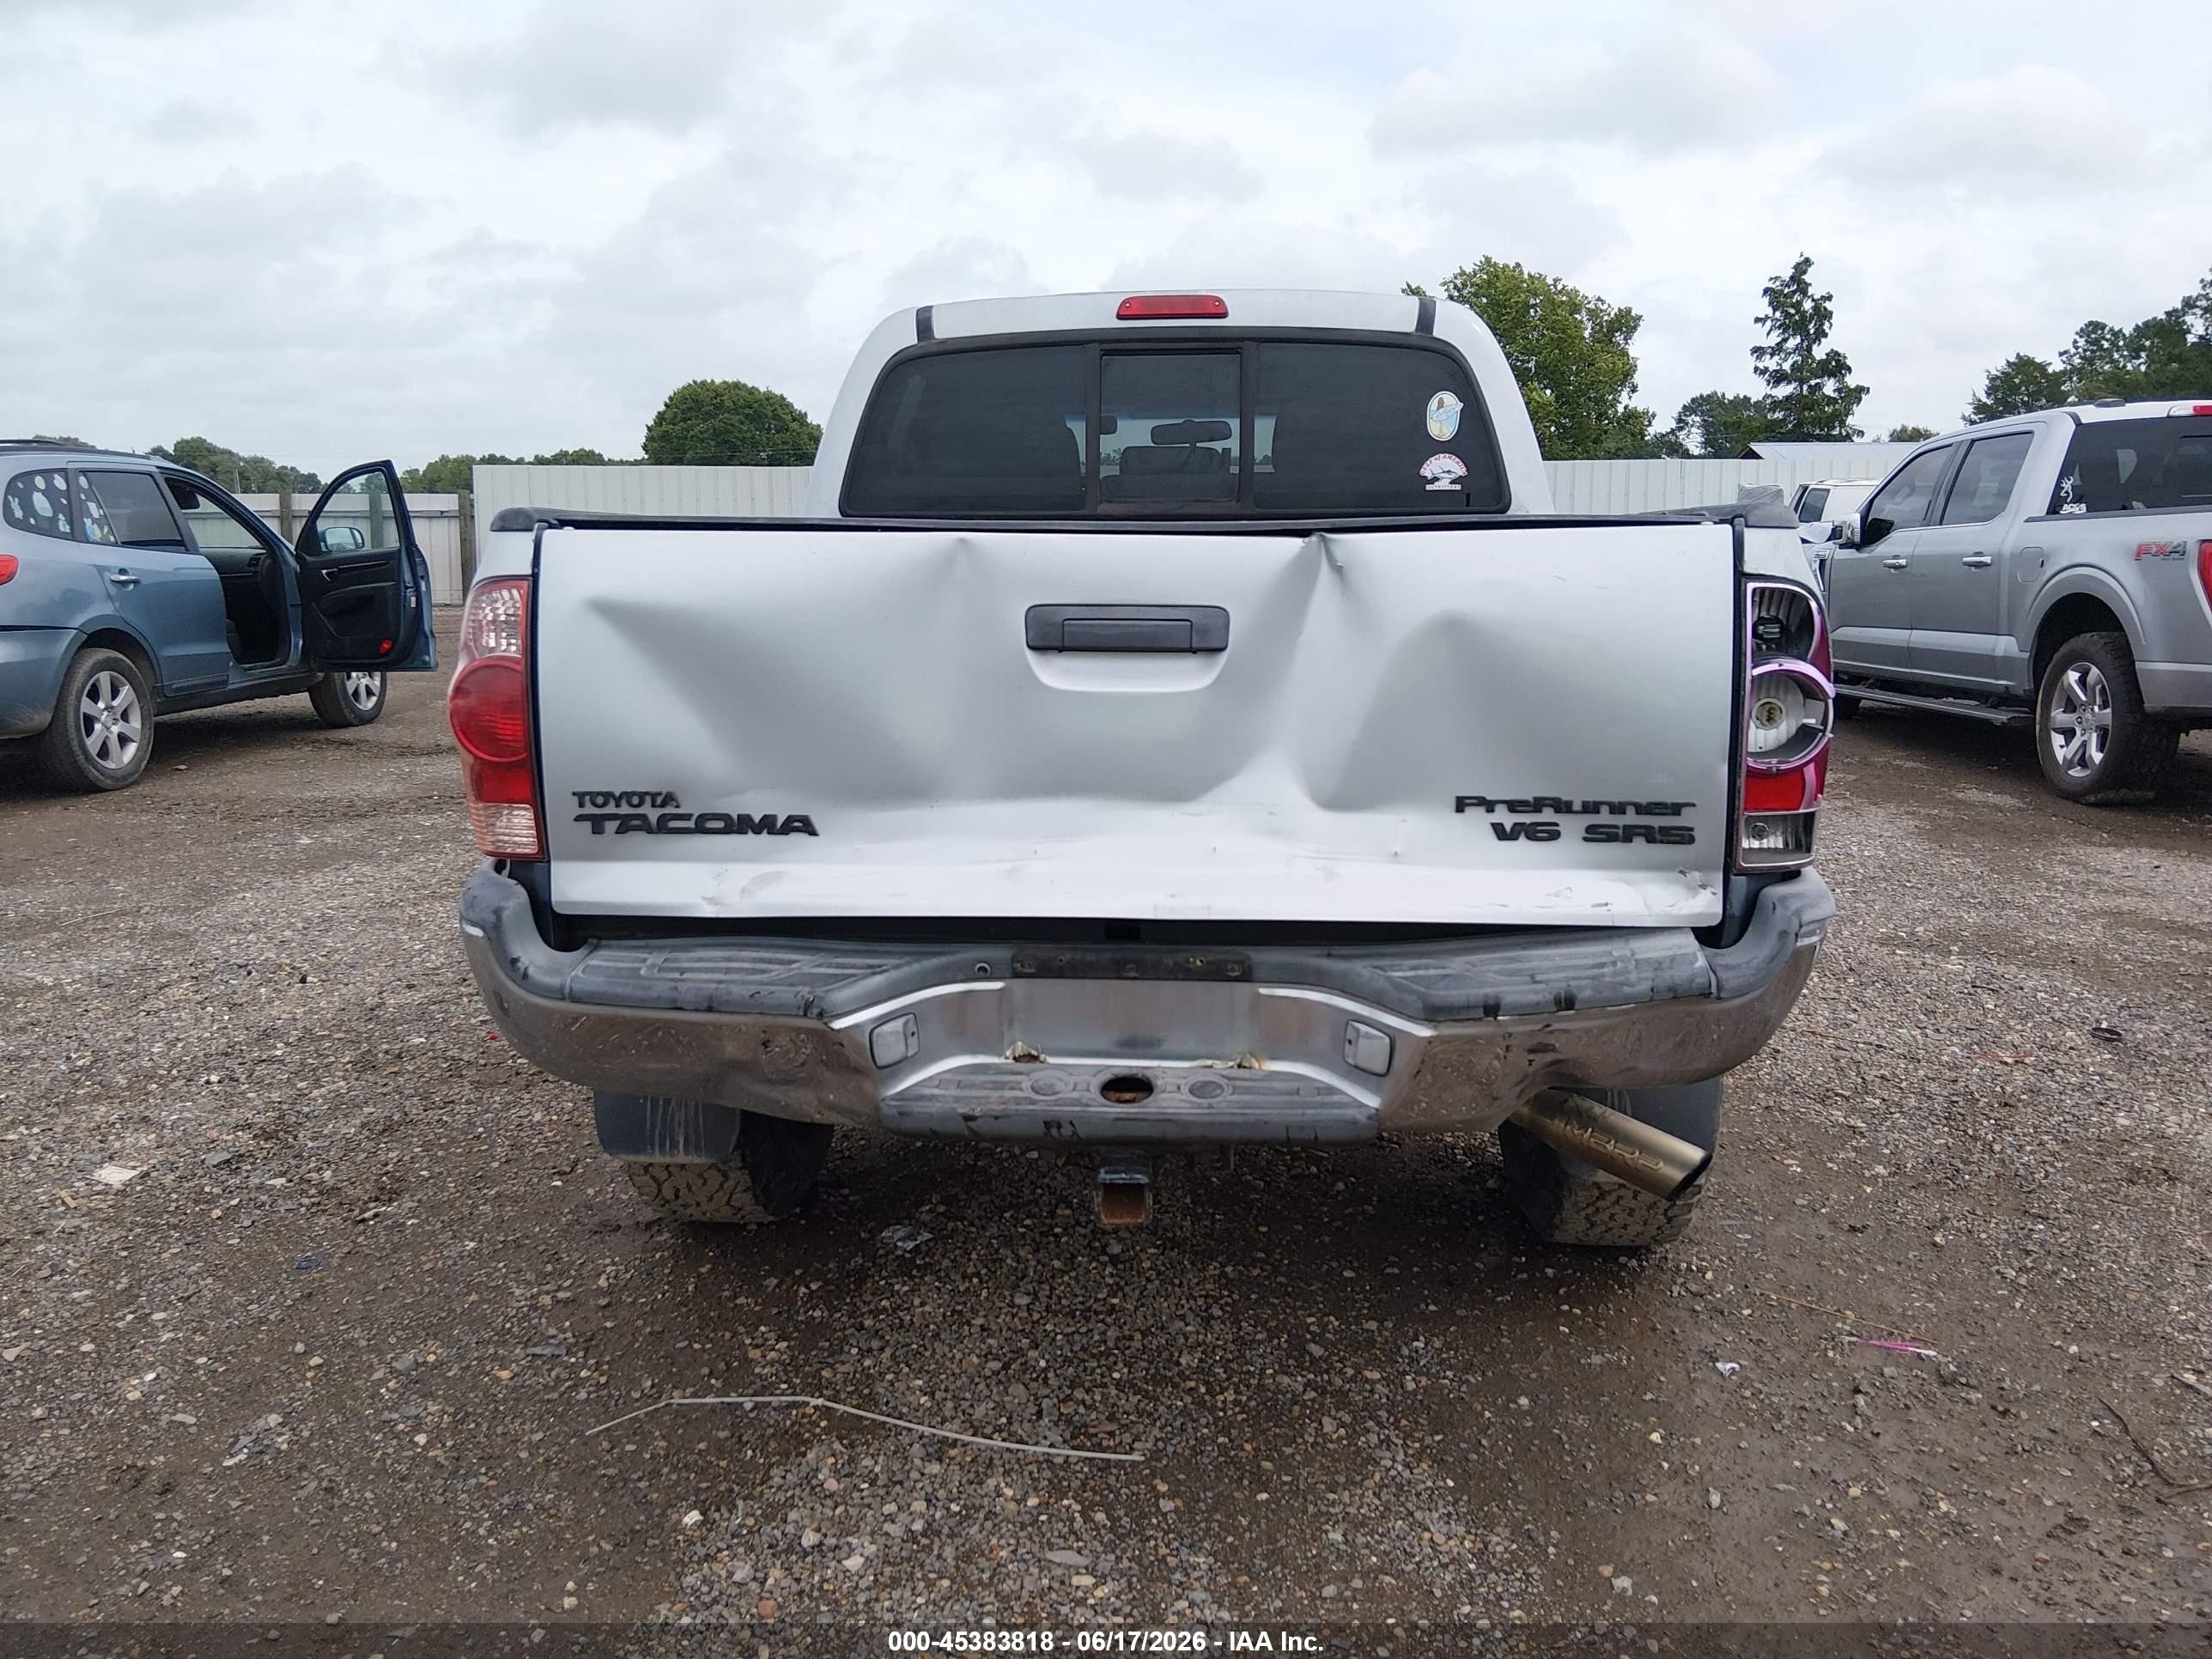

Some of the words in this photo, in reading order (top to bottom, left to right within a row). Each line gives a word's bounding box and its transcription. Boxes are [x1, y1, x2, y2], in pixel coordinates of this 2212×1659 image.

[2134, 541, 2188, 561] FX4
[572, 790, 681, 809] TOYOTA
[1455, 795, 1698, 817] PreRunner
[573, 812, 820, 836] TACOMA
[1490, 821, 1562, 842] V6
[1582, 823, 1696, 845] SR5
